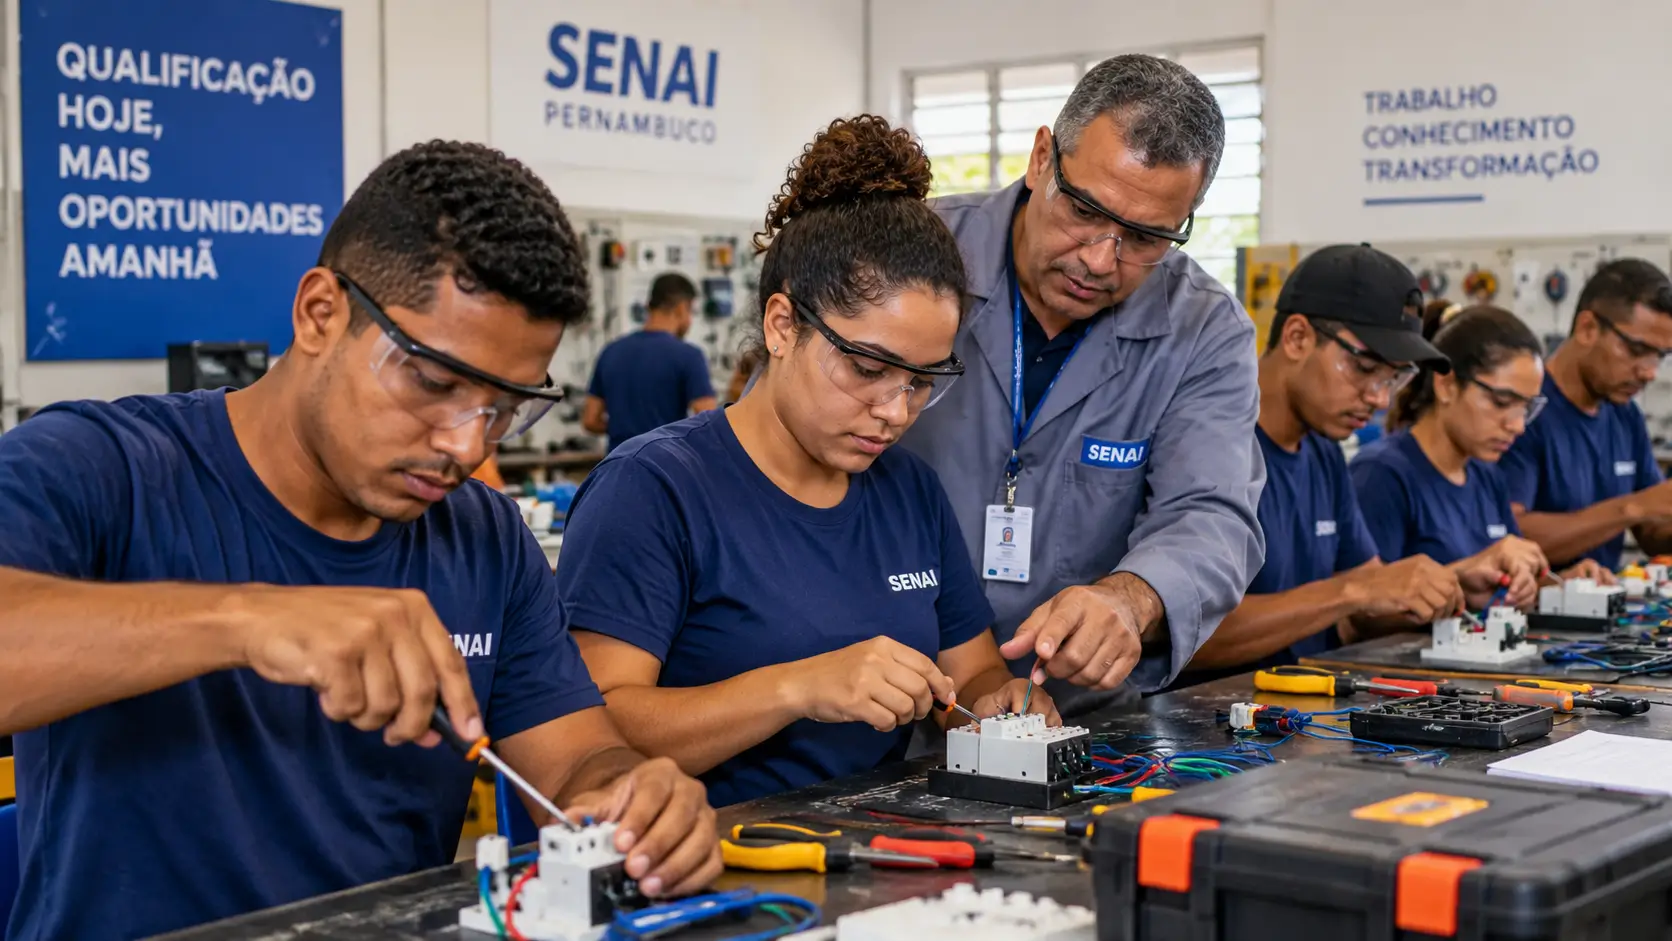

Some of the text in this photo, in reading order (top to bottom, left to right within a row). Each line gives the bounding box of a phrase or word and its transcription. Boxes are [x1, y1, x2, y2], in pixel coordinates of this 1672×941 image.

[57, 43, 315, 104] QUALIFICAÇÃO
[545, 22, 718, 108] SENAI
[58, 94, 163, 140] HOJE,
[1363, 84, 1497, 113] TRABALHO
[545, 101, 717, 144] PERNAMBUCO
[1362, 115, 1575, 149] CONHECIMENTO
[59, 144, 150, 182] MAIS
[1363, 146, 1600, 181] TRANSFORMAÇÃO
[59, 194, 324, 236] OPORTUNIDADES
[59, 239, 218, 279] AMANHÃ
[1088, 445, 1144, 463] SENAI
[888, 569, 938, 592] SENAI
[449, 632, 493, 657] NAI
